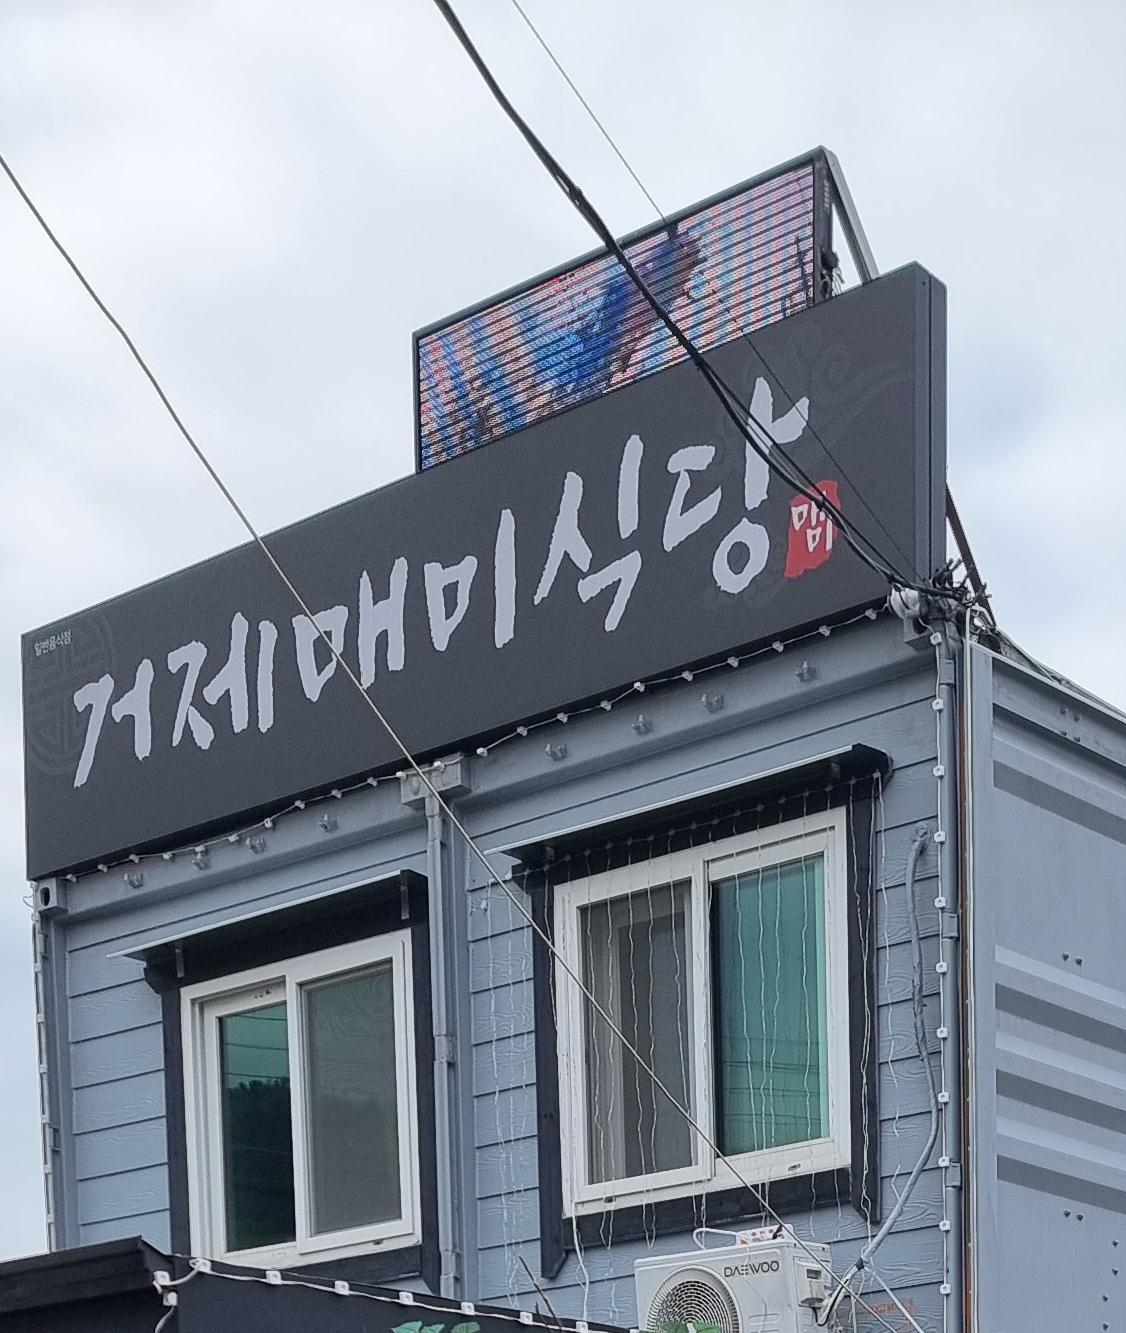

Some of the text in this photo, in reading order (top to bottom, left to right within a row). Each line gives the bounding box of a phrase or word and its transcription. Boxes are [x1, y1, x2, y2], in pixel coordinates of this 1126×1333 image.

[73, 377, 809, 788] 거제매미식당
[34, 629, 71, 656] 일반음식점
[724, 1261, 779, 1277] DAEWOO
